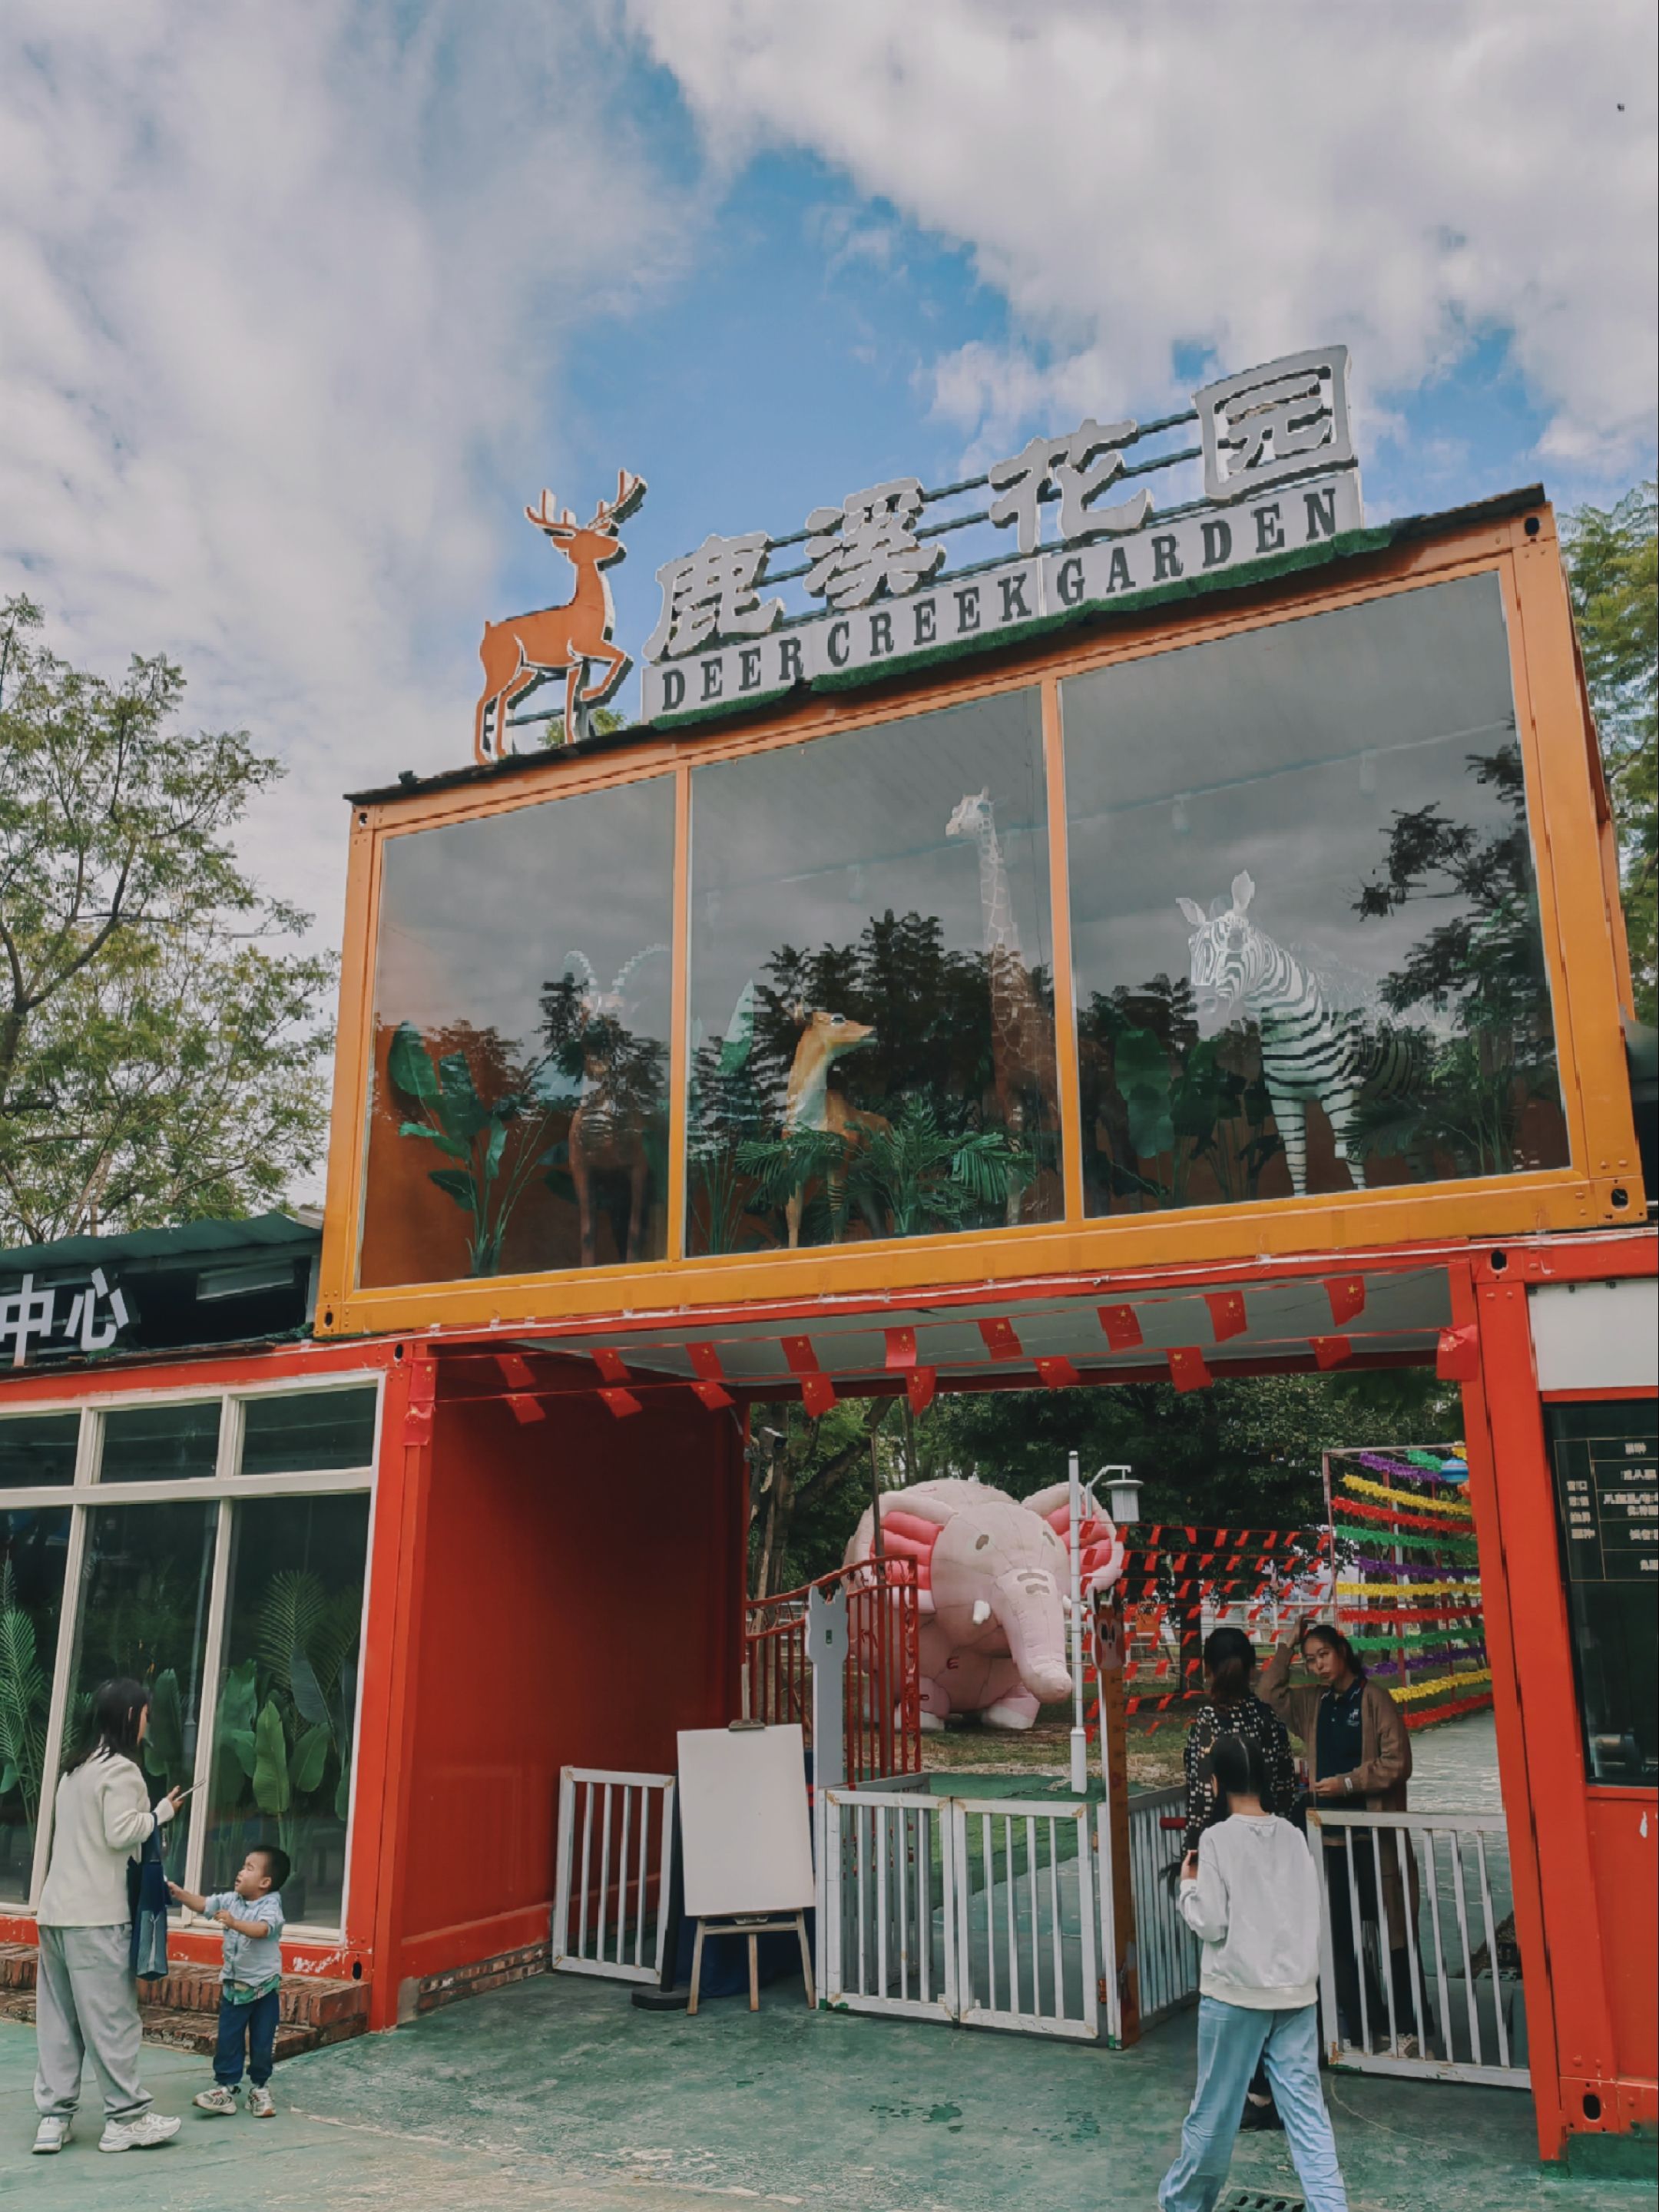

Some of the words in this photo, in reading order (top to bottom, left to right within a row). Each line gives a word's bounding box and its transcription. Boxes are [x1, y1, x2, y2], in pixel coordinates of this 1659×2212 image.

[641, 345, 1353, 662] 鹿溪花园
[1057, 488, 1336, 606] GARDEN
[0, 1267, 129, 1366] 中心
